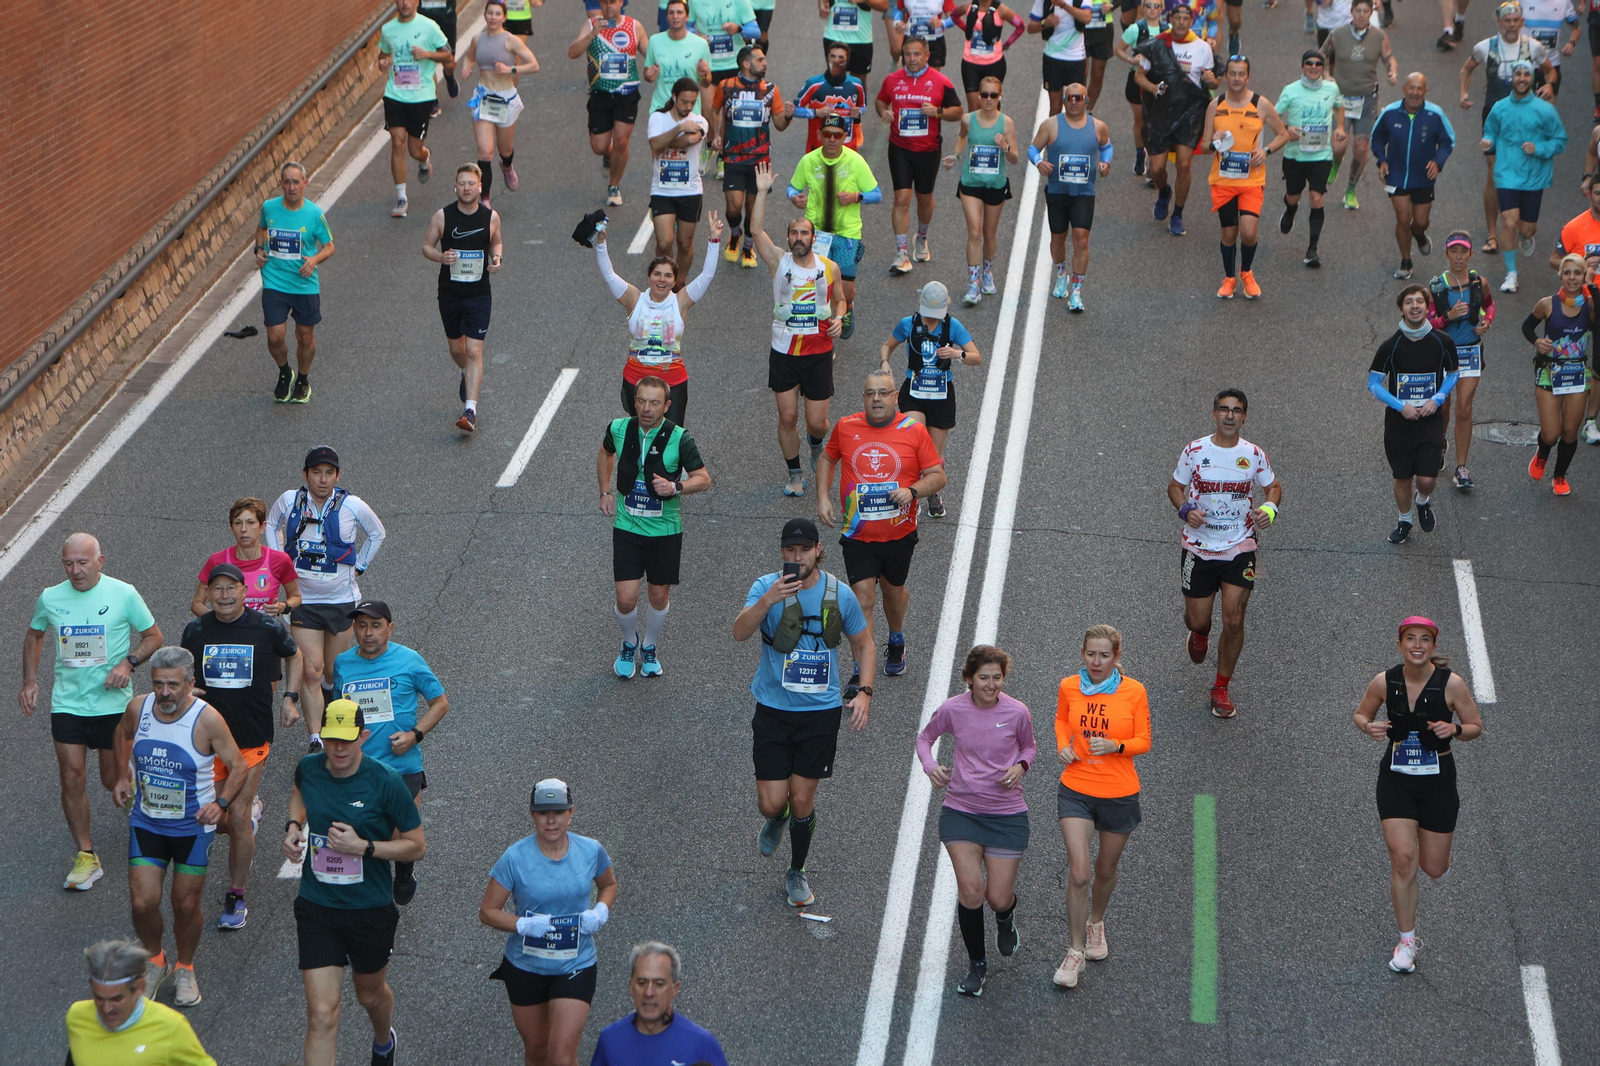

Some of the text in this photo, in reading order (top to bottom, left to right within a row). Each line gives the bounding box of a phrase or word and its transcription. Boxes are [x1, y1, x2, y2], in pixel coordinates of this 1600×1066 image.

[74, 627, 100, 635] ZURICH
[801, 653, 826, 661] ZURICH
[798, 667, 817, 675] 12312
[358, 682, 384, 690] ZURICH
[358, 697, 375, 705] 8914
[1087, 702, 1107, 717] WE
[1079, 715, 1109, 731] RUN
[152, 747, 168, 758] ADS
[137, 755, 183, 771] eMotion
[145, 765, 174, 777] running
[149, 792, 170, 801] 11042
[326, 855, 343, 864] 8205
[326, 866, 344, 874] BRETT
[550, 917, 573, 925] URICH
[542, 933, 563, 941] 2843
